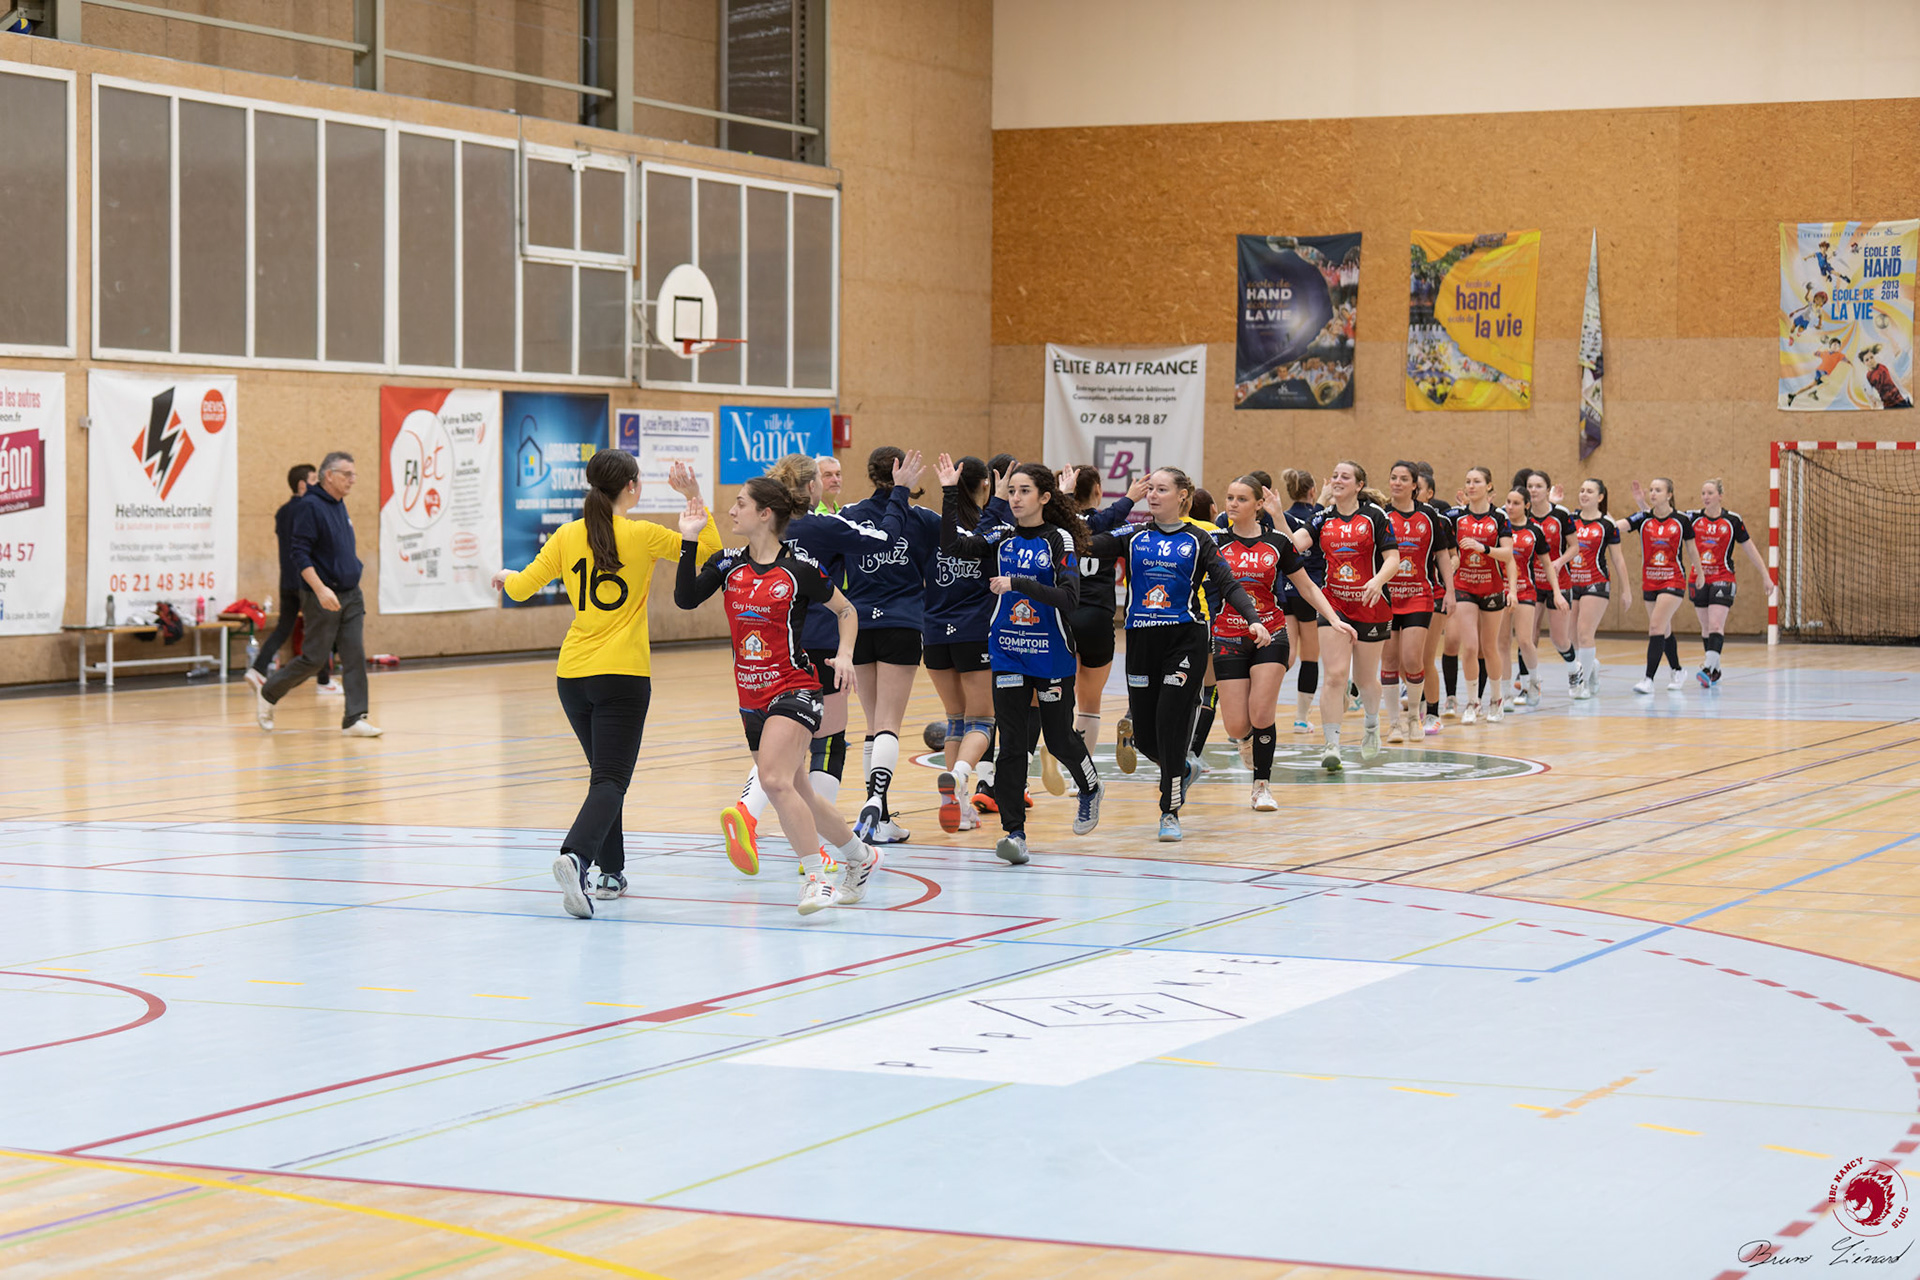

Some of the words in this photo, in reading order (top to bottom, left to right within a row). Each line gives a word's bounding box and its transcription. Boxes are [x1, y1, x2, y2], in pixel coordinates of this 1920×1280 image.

[1864, 244, 1888, 258] ÉCOLE
[1891, 245, 1901, 257] DE
[1863, 257, 1902, 278] HAND
[1881, 280, 1900, 290] 2013
[1246, 288, 1292, 300] HAND
[1456, 283, 1501, 311] hand
[1832, 285, 1860, 301] ÉCOLE
[1863, 288, 1874, 301] DE
[1880, 290, 1899, 300] 2014
[1245, 309, 1265, 321] LA
[1267, 309, 1292, 321] VIE
[1830, 302, 1848, 321] LA
[1853, 301, 1874, 321] VIE
[1475, 312, 1491, 339] la
[1496, 312, 1522, 338] vie
[1095, 361, 1131, 375] BATI
[1134, 361, 1198, 375] FRANCE
[1076, 385, 1106, 394] Entreprise
[1107, 386, 1134, 394] générale
[1136, 385, 1144, 393] de
[5, 386, 16, 408] les
[18, 388, 41, 408] autres
[1145, 394, 1154, 402] de
[1154, 394, 1178, 403] projets
[764, 413, 782, 430] ville
[783, 413, 795, 430] de
[1080, 412, 1097, 424] 07
[1099, 413, 1114, 424] 68
[1117, 414, 1131, 425] 54
[1134, 414, 1149, 425] 28
[1152, 414, 1168, 425] 87
[729, 411, 811, 463] Nancy
[0, 437, 32, 491] éon
[115, 503, 213, 518] HelloHomeLorraine
[1339, 523, 1352, 538] 14
[1472, 522, 1484, 534] 11
[1706, 524, 1717, 534] 33
[17, 543, 35, 561] 57
[1331, 541, 1341, 549] Guy
[1018, 549, 1033, 569] 12
[1143, 559, 1155, 567] Guy
[1156, 560, 1177, 569] Hoquet
[1238, 552, 1258, 568] 24
[110, 573, 128, 592] 06
[133, 573, 151, 592] 21
[156, 573, 174, 591] 48
[178, 572, 194, 591] 34
[198, 571, 215, 590] 46
[571, 557, 629, 611] 16
[748, 579, 763, 599] 7
[1389, 586, 1423, 594] OMPTOIR
[731, 601, 745, 612] Guy
[745, 601, 771, 613] Hoquet
[998, 636, 1049, 649] COMPTOIR
[737, 671, 780, 683] COMPTOIR
